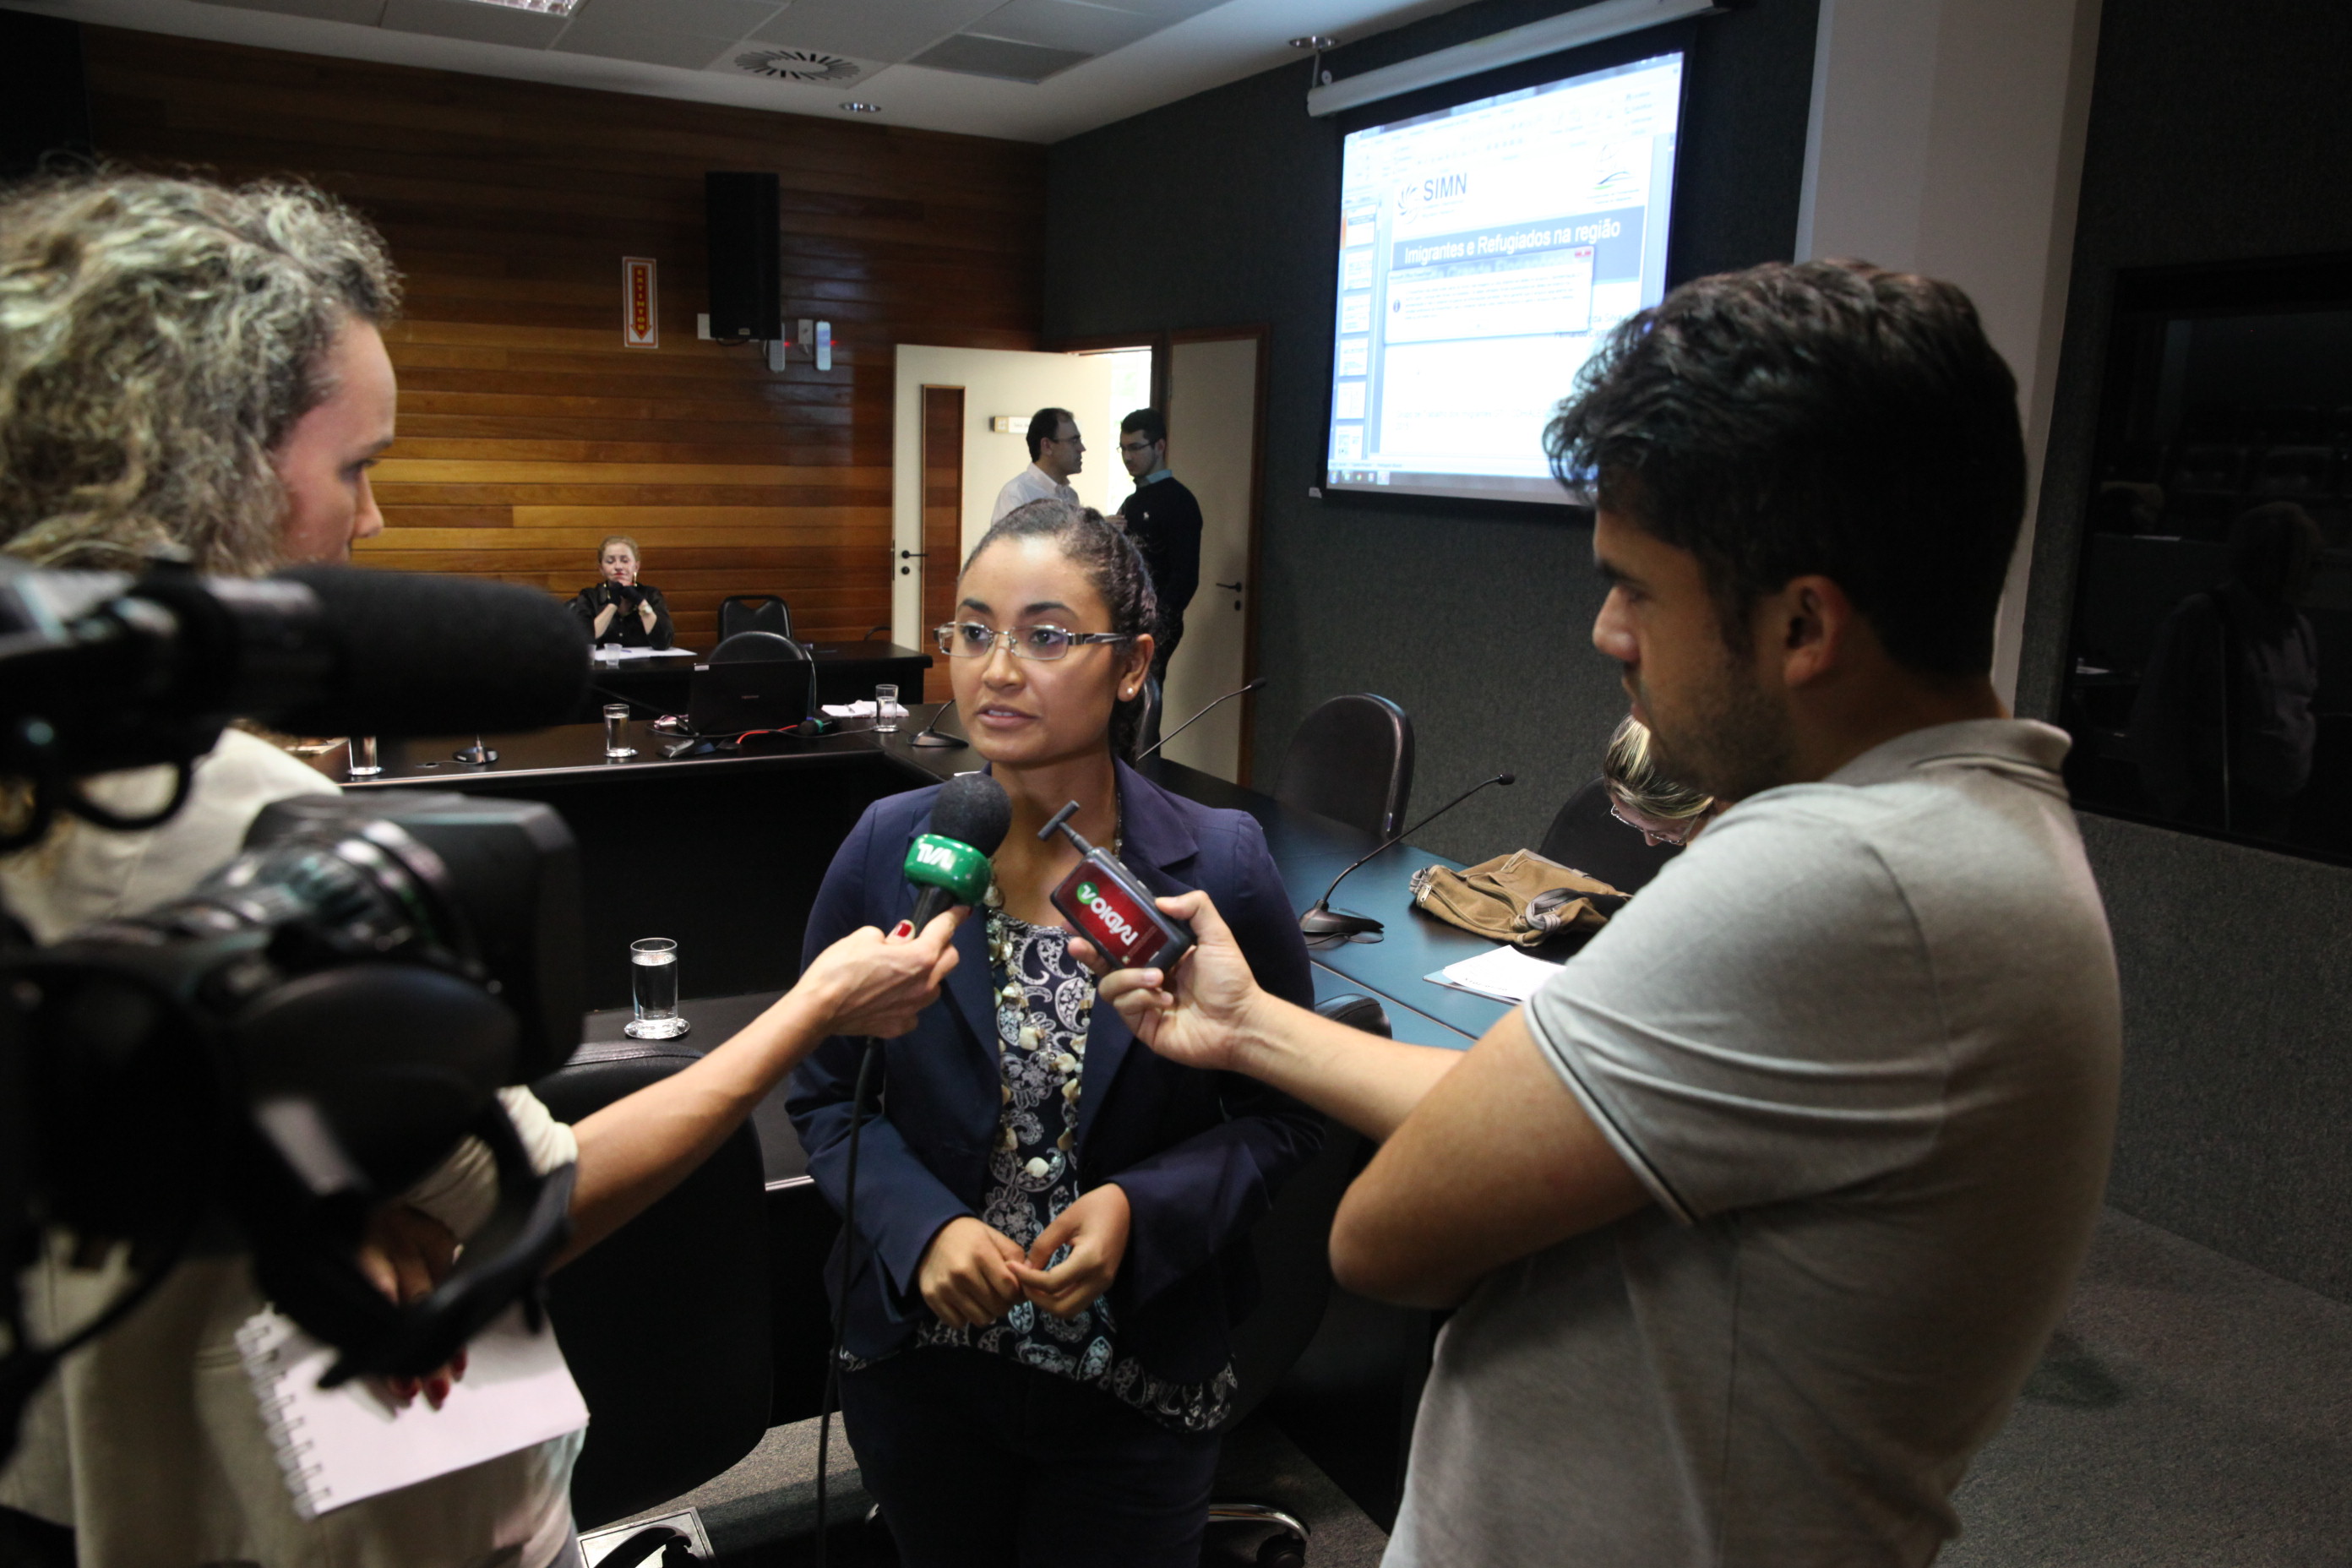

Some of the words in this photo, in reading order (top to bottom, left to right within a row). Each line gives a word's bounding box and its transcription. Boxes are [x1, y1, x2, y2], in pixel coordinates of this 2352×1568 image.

[1423, 172, 1467, 202] SIMN
[1404, 240, 1466, 266] Imigrantes
[1466, 239, 1474, 257] e
[1478, 228, 1551, 255] Refugiados
[1554, 226, 1572, 245] na
[1574, 217, 1621, 245] região
[1090, 896, 1139, 947] RÁDIO
